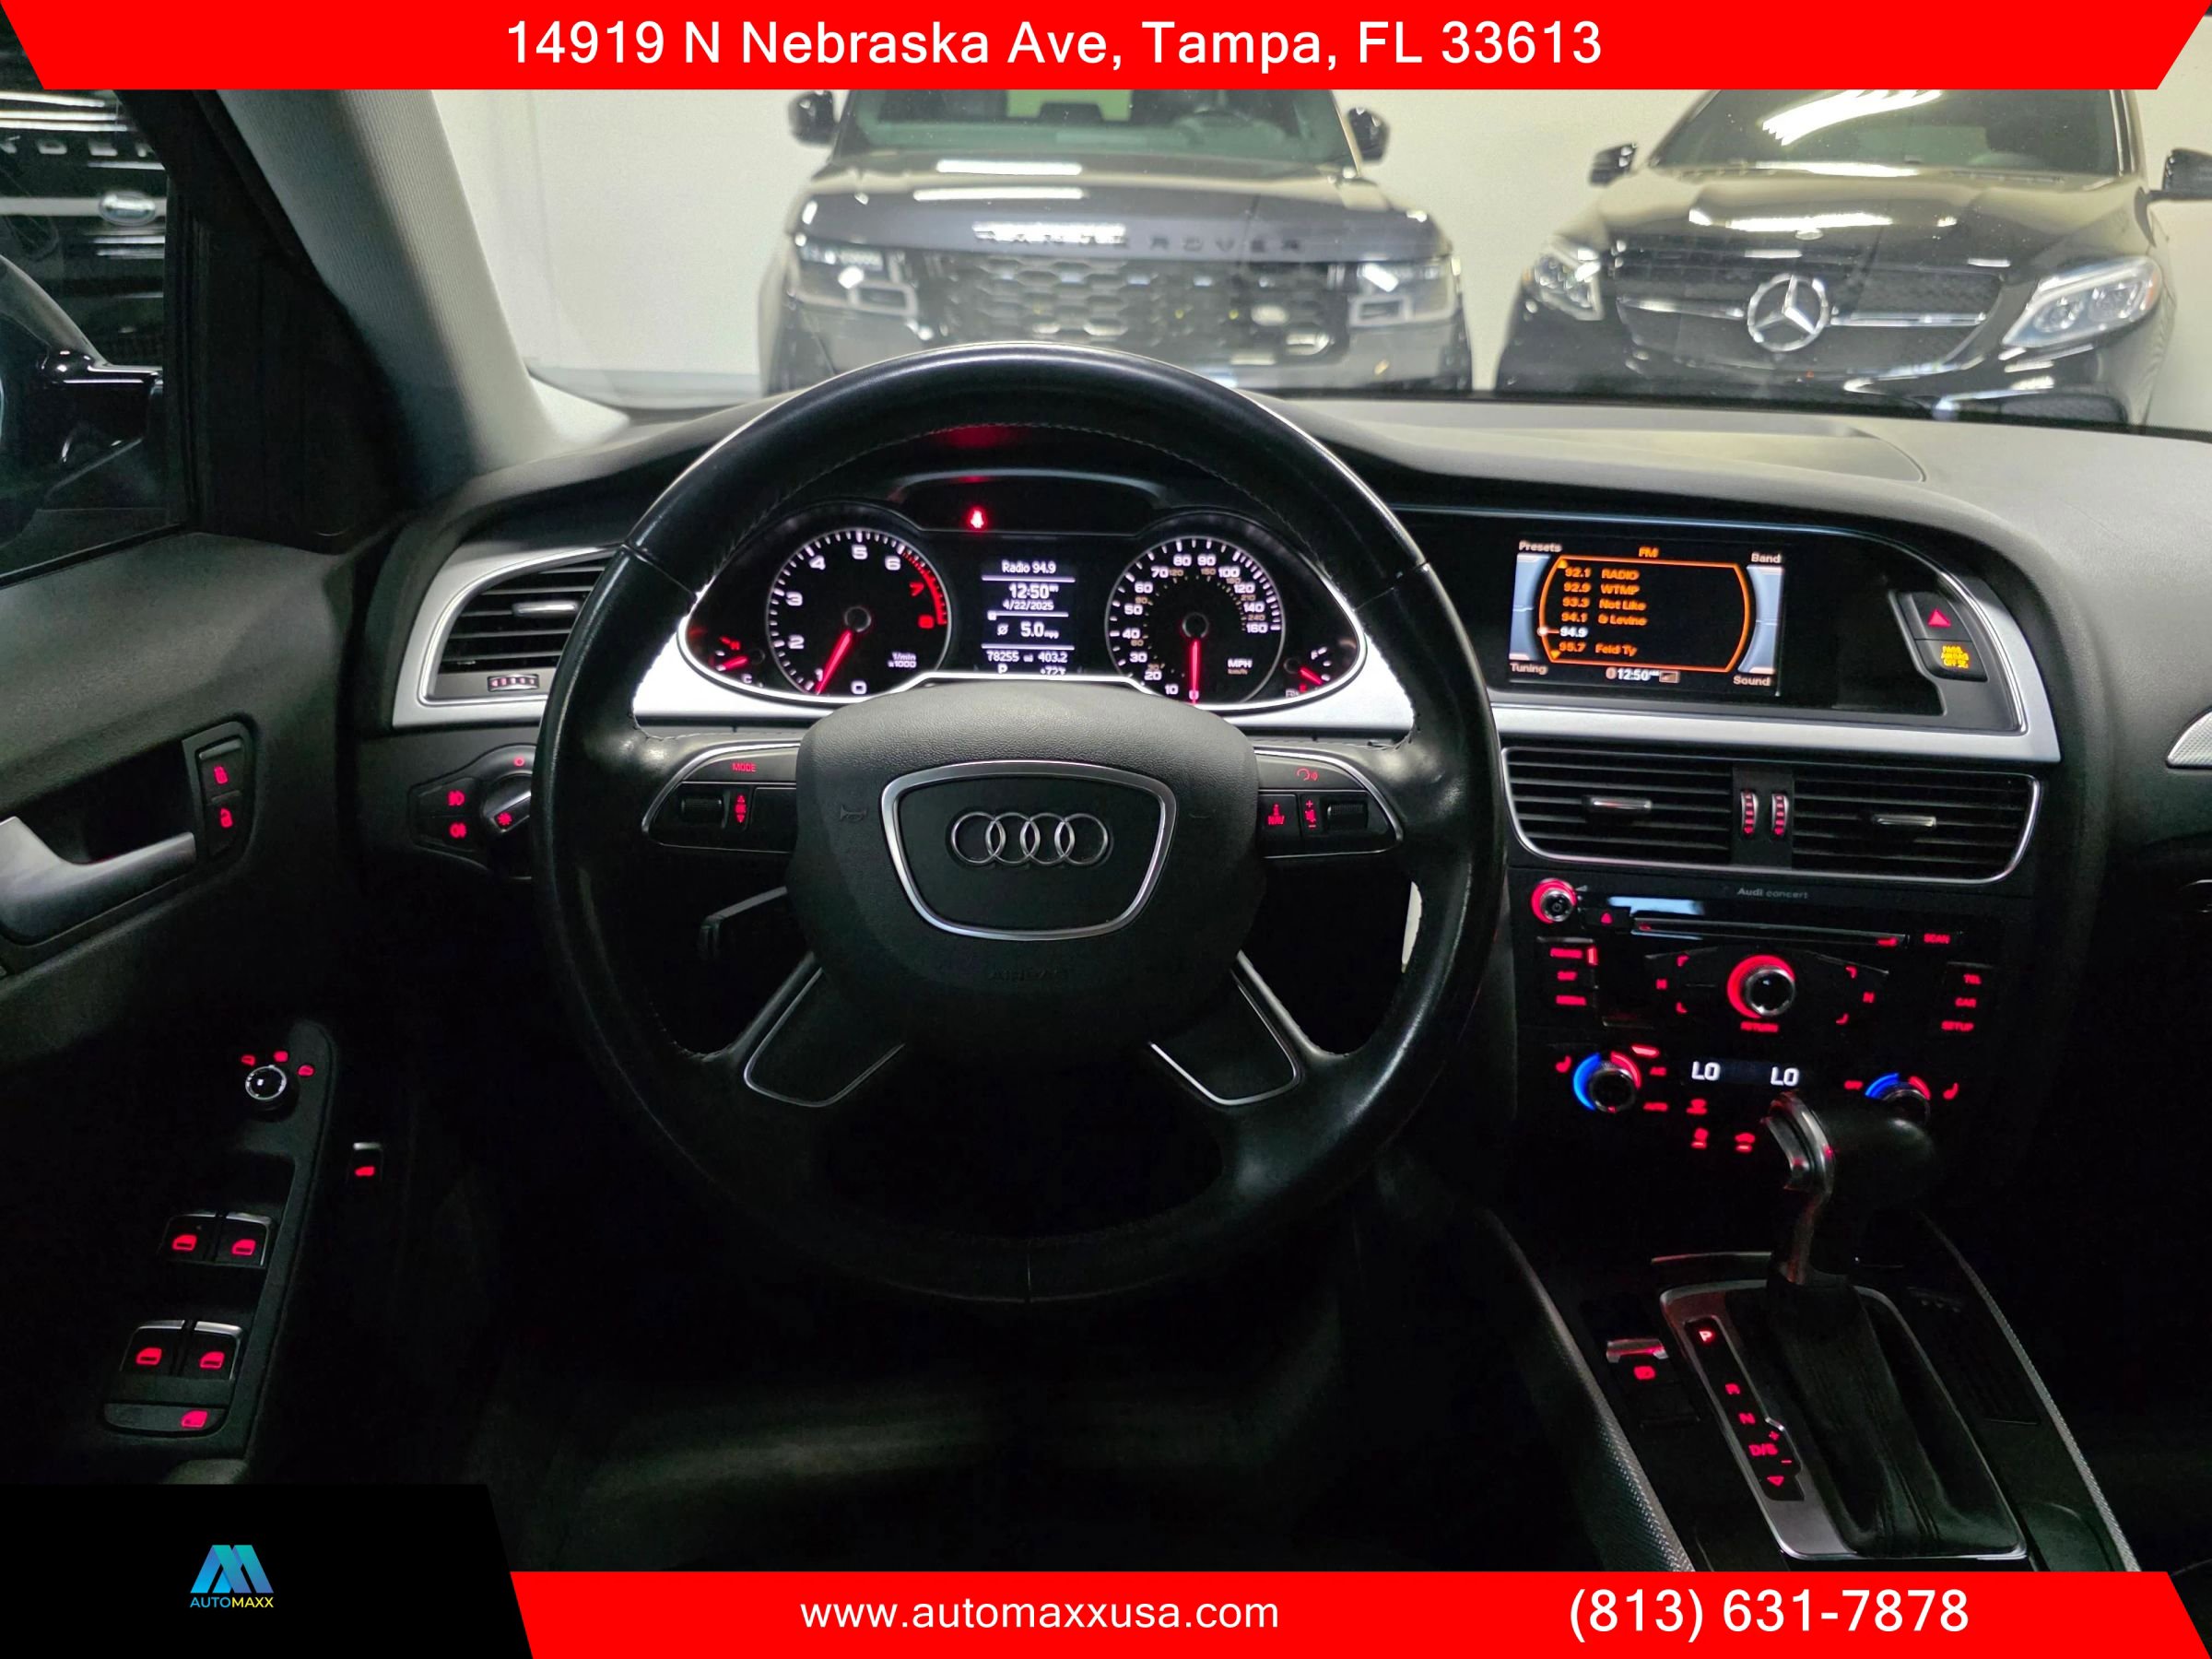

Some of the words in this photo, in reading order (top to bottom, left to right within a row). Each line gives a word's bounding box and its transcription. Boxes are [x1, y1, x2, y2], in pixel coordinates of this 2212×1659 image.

[852, 545, 868, 559] 5
[1519, 541, 1562, 554] Presets
[1639, 547, 1660, 559] FM
[808, 556, 826, 571] 4
[884, 557, 901, 571] 6
[1173, 554, 1192, 566] 80
[1197, 554, 1217, 567] 90
[1751, 553, 1782, 565] Band
[1001, 559, 1030, 573] Radio
[1031, 560, 1056, 574] 94.9
[1151, 566, 1170, 578] 70
[1218, 566, 1241, 578] 100
[1601, 568, 1641, 581] RADIO
[909, 582, 924, 596] 7
[1009, 583, 1050, 600] 12:50
[1135, 582, 1153, 594] 60
[1233, 582, 1255, 594] 120
[1601, 583, 1641, 595] WTMP
[786, 592, 803, 606] 3
[1002, 599, 1054, 611] 4/22/2025
[1599, 598, 1621, 610] Not
[1622, 600, 1648, 611] Like
[1124, 604, 1143, 615] 50
[1243, 602, 1265, 613] 140
[1609, 614, 1648, 626] Levine
[1020, 620, 1044, 637] 5.0
[1122, 628, 1141, 640] 40
[1246, 622, 1269, 633] 160
[1559, 626, 1589, 638] 94.9
[787, 635, 805, 649] 2
[986, 650, 1020, 663] 78255
[1037, 651, 1068, 664] 403.2
[1129, 652, 1148, 663] 30
[1228, 658, 1253, 669] MPH
[1144, 670, 1162, 681] 20
[1510, 662, 1548, 677] Tuning
[1617, 667, 1650, 681] 12:50
[851, 680, 867, 694] 0
[1733, 675, 1771, 688] Sound
[1164, 684, 1179, 695] 10
[731, 762, 758, 772] MODE
[1737, 887, 1764, 896] Audi
[1766, 888, 1809, 900] concert
[1941, 1019, 1974, 1032] SETUP
[1691, 1062, 1722, 1082] LO
[1770, 1067, 1800, 1087] LO
[1699, 1329, 1713, 1342] P
[1738, 1412, 1756, 1425] N
